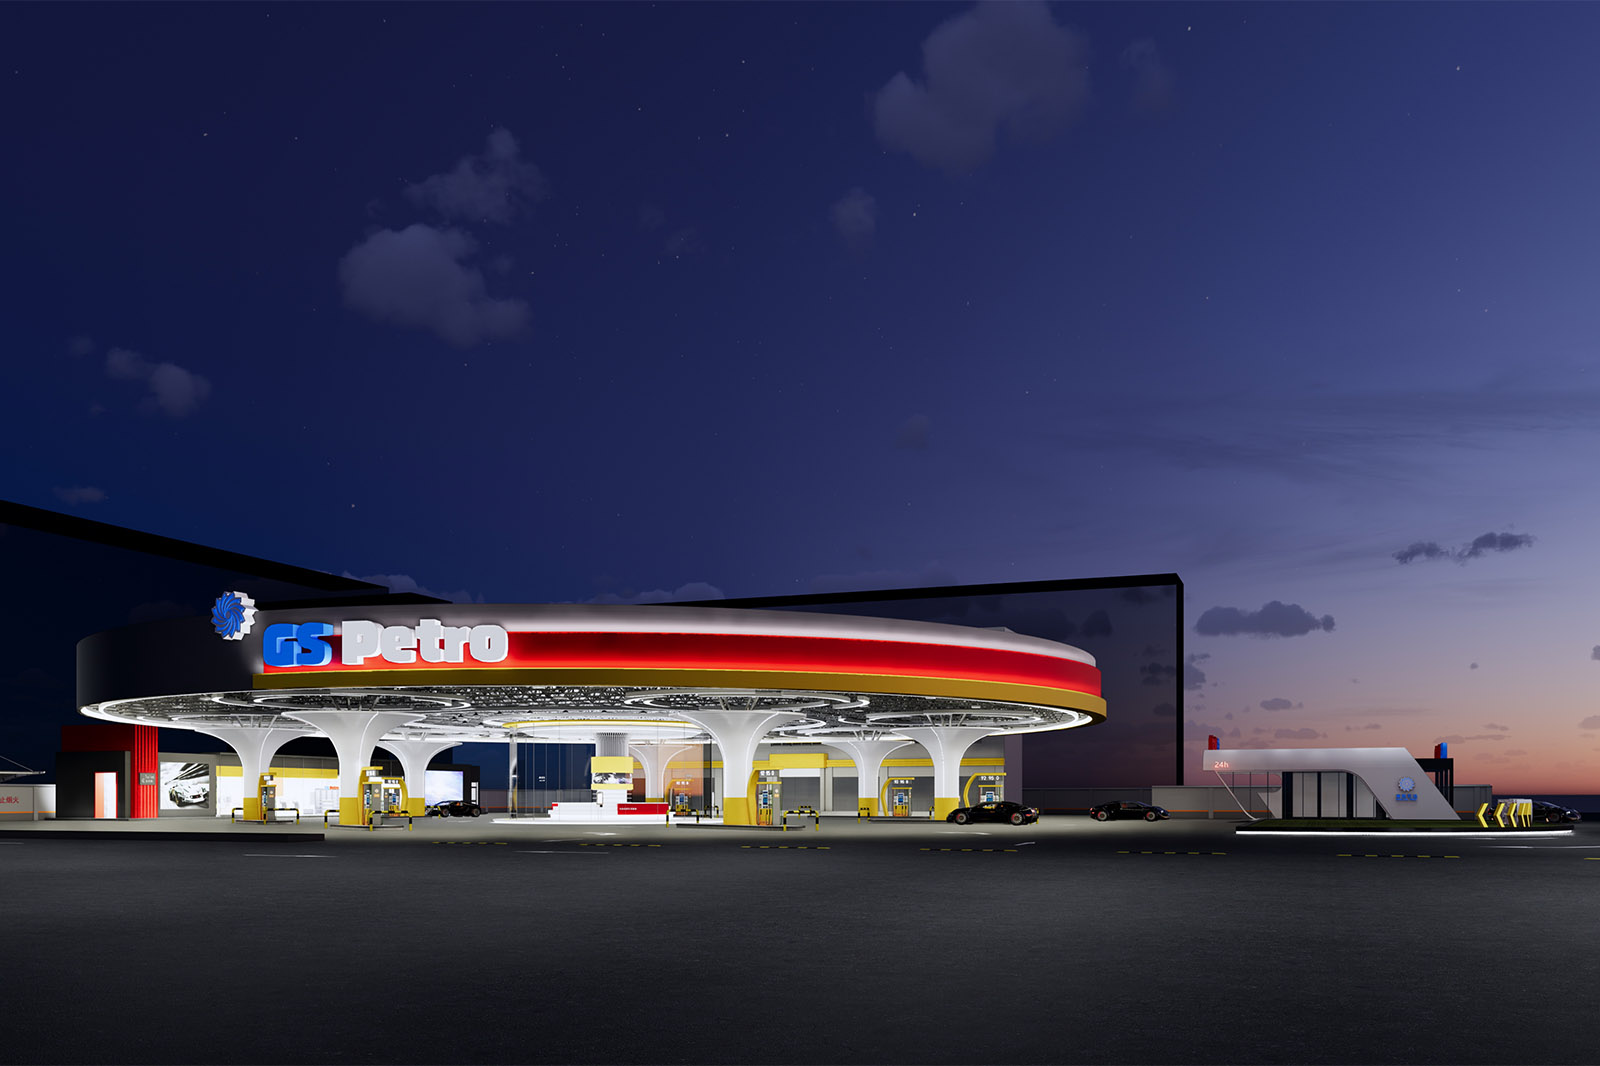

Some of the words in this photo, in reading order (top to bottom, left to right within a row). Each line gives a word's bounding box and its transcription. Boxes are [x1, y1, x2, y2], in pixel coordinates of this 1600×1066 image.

[263, 622, 333, 667] GS
[341, 618, 509, 665] Petro
[1214, 761, 1229, 769] 24h
